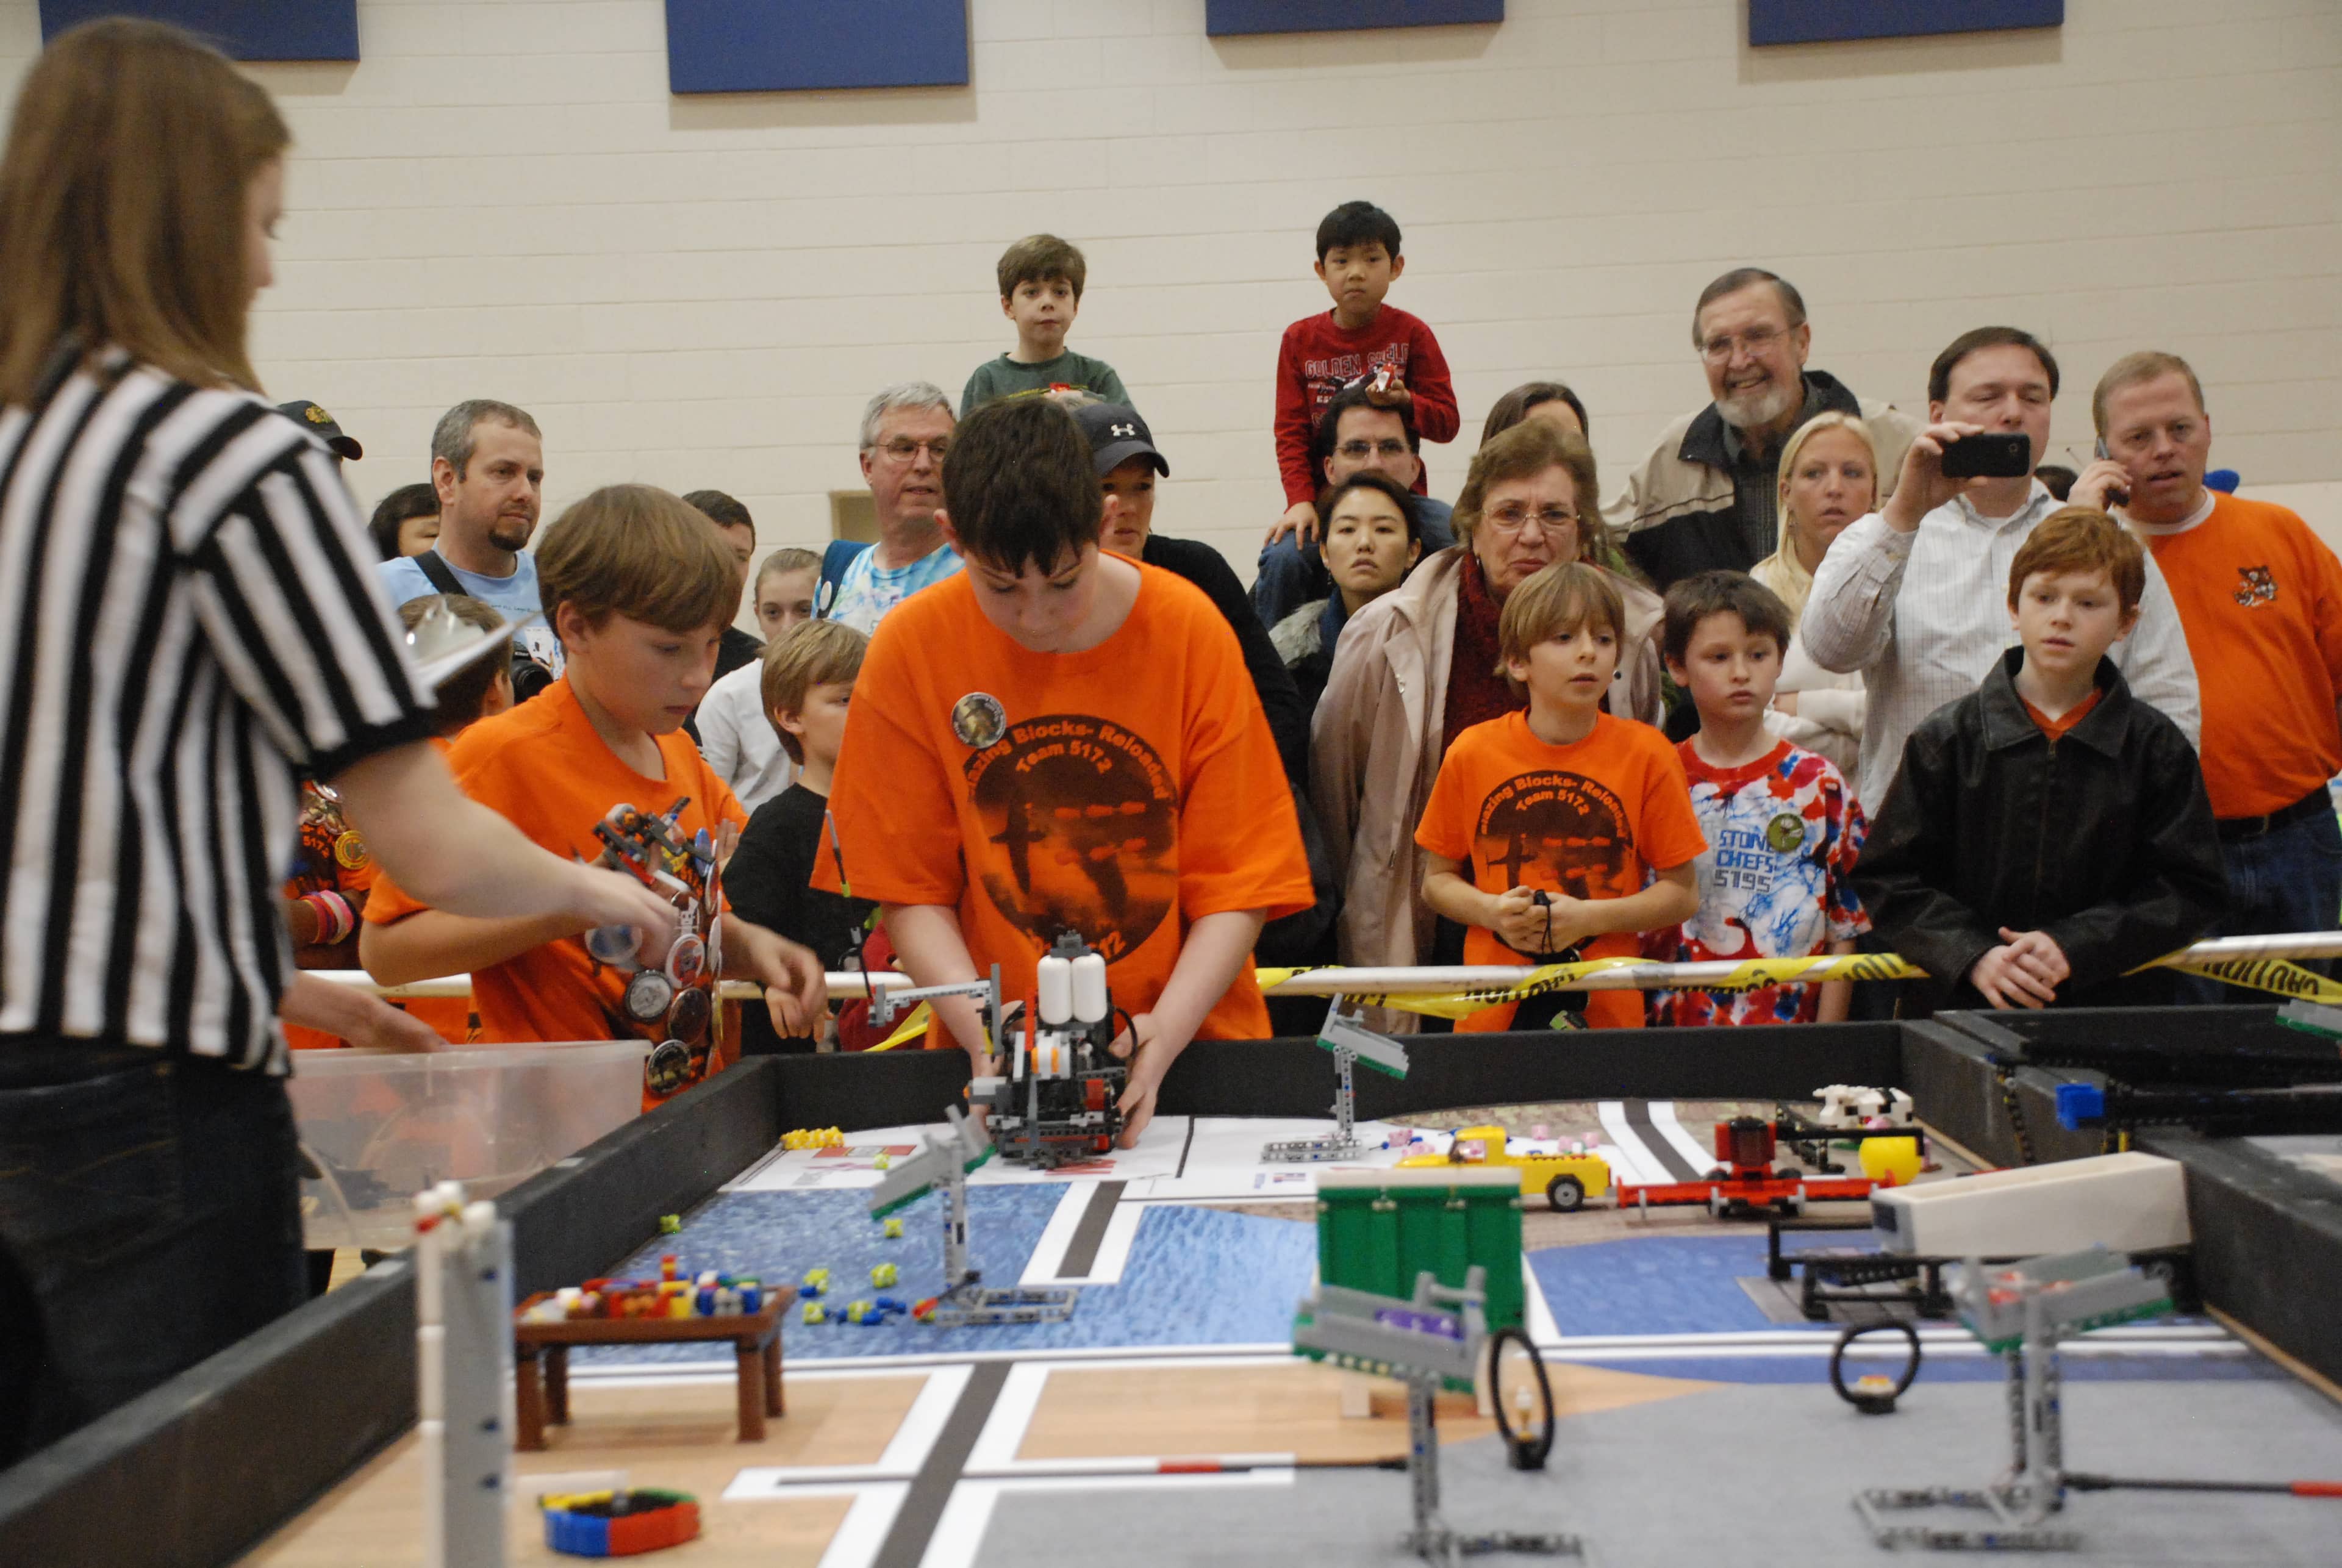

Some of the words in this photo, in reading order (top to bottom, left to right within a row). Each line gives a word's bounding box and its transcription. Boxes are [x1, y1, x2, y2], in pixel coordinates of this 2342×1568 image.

[1305, 353, 1363, 379] GOLDEN
[1015, 743, 1065, 773] Team
[1070, 740, 1113, 775] 5172
[1516, 790, 1554, 811] Team
[1557, 789, 1591, 816] 5172
[1716, 849, 1774, 874] CHEFS
[1713, 868, 1772, 893] 5195
